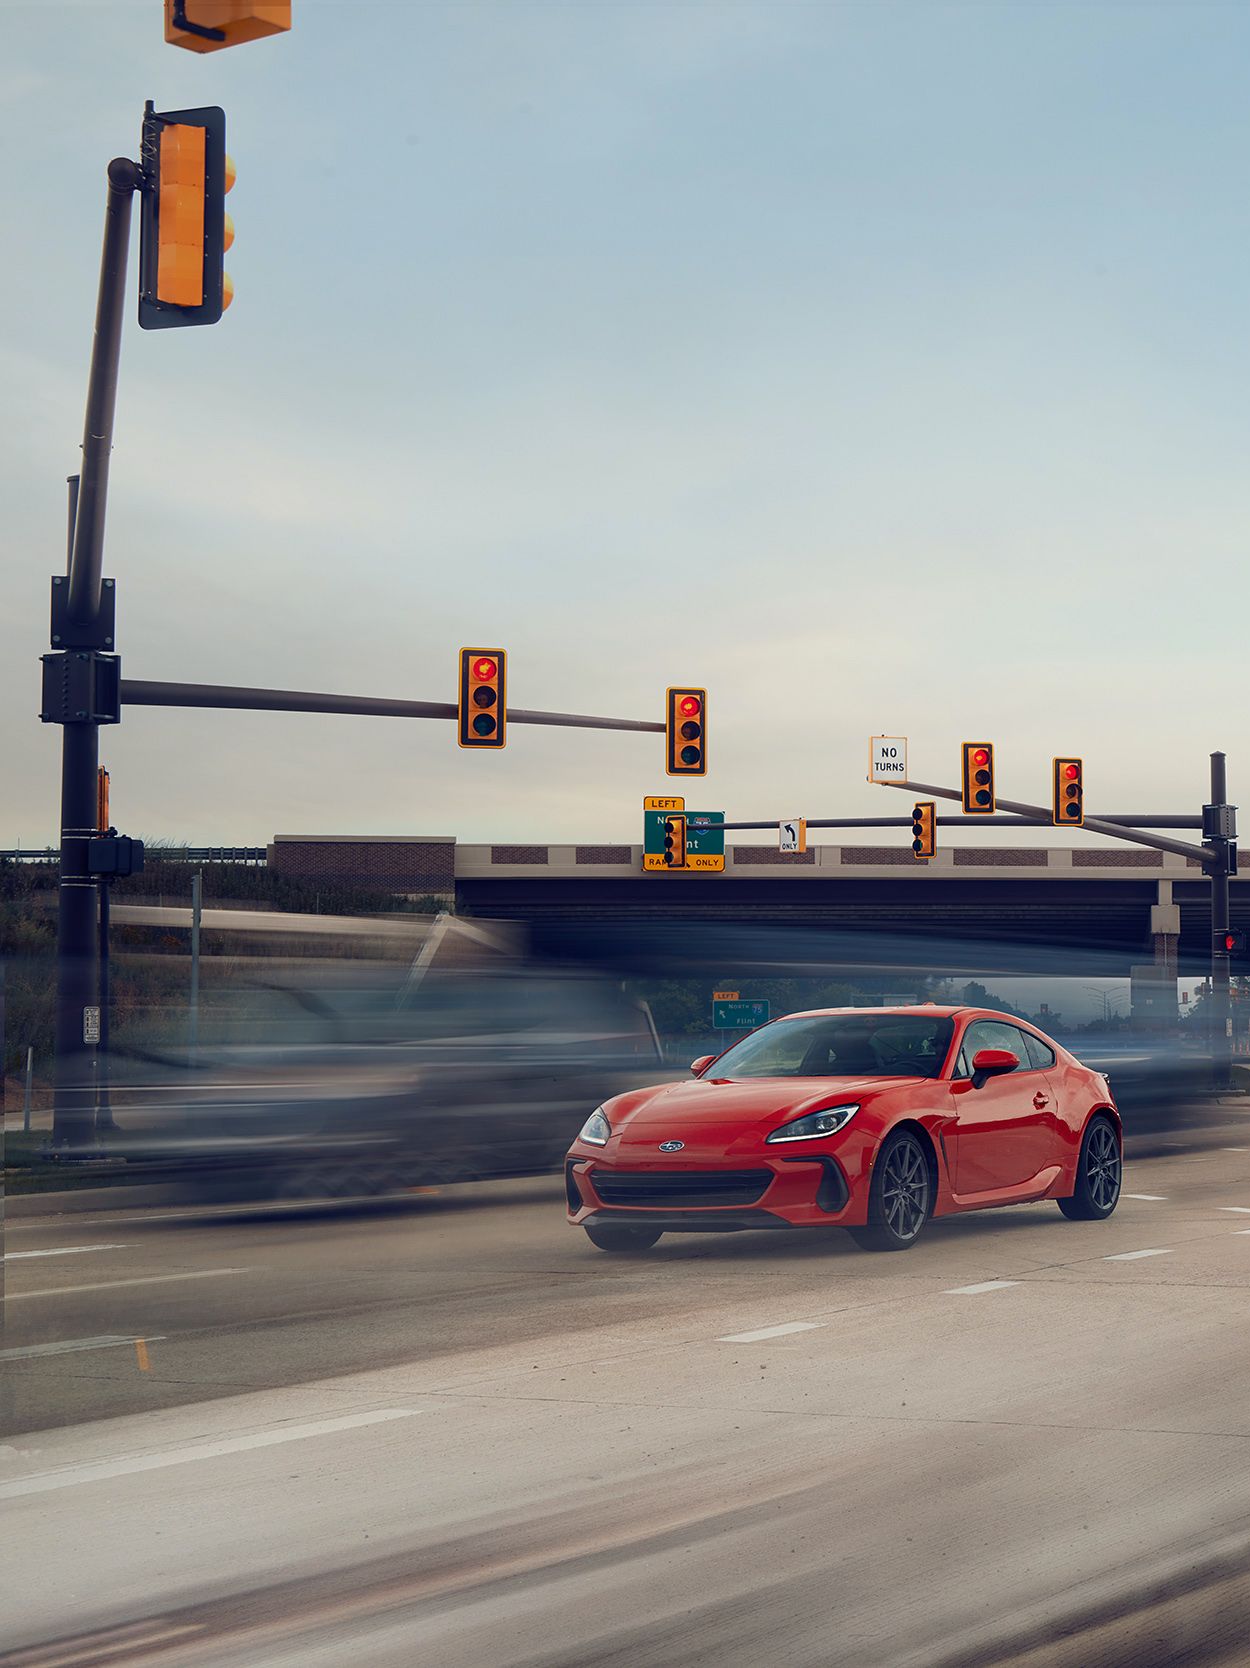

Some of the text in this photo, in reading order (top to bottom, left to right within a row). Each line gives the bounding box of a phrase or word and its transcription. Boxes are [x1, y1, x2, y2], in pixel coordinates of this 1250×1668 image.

[881, 747, 898, 758] NO
[875, 762, 905, 772] TURNS
[651, 800, 677, 808] LEFT
[695, 859, 720, 867] ONLY
